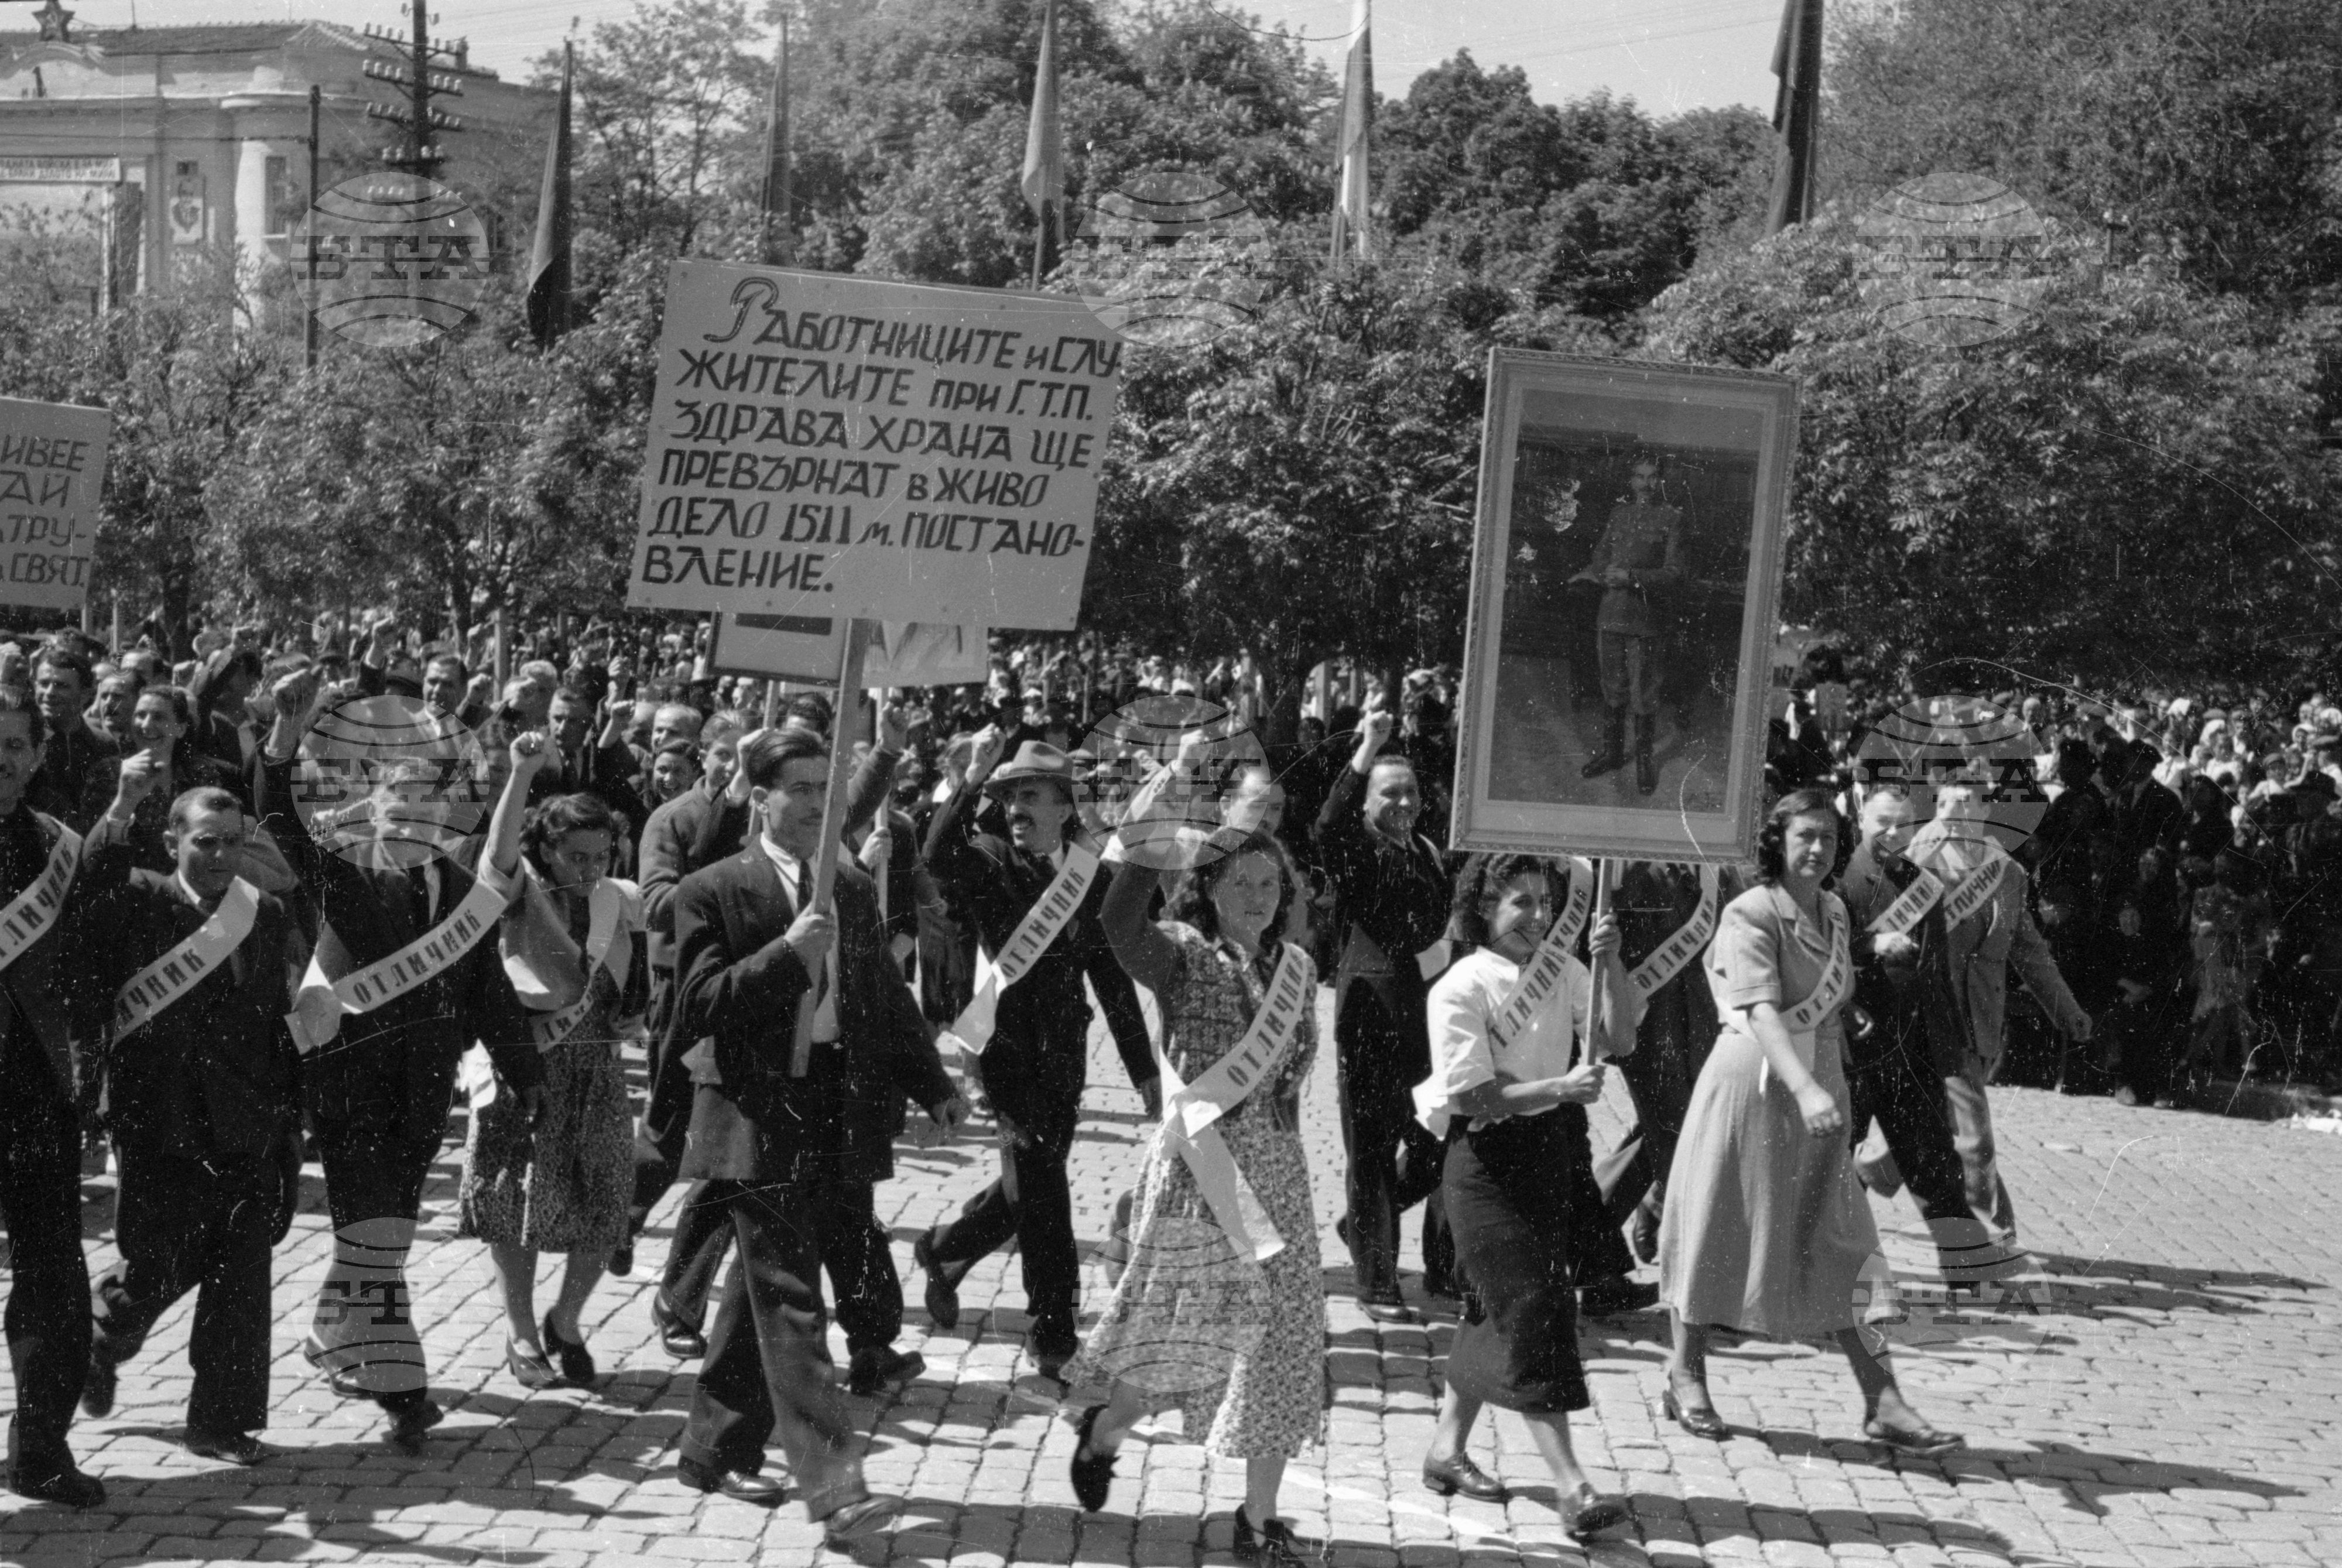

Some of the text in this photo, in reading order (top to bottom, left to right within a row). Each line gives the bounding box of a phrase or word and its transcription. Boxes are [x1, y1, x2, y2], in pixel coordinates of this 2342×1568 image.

[703, 276, 1022, 369] РАБОТНИЦИТЕ
[1050, 337, 1122, 378] СЛУ-
[674, 348, 915, 406] ЖИТЕЛИТЕ
[669, 399, 1095, 471] ЗДРАВА ХРАНА ЩЕ
[658, 447, 900, 498] ПРЕВЪРНАТ
[932, 467, 1050, 508] ЖИВО
[8, 514, 87, 547] ТРУ-
[647, 495, 771, 540] ДЕЛО
[900, 511, 1086, 557] ПОСТАНО-
[642, 545, 834, 593] ВЛЕНИЕ.
[0, 848, 74, 958] ЛИЧНИК
[1000, 867, 1086, 978] ОТЛИЧНИК
[352, 909, 482, 1004] ОТЛИЧНИК
